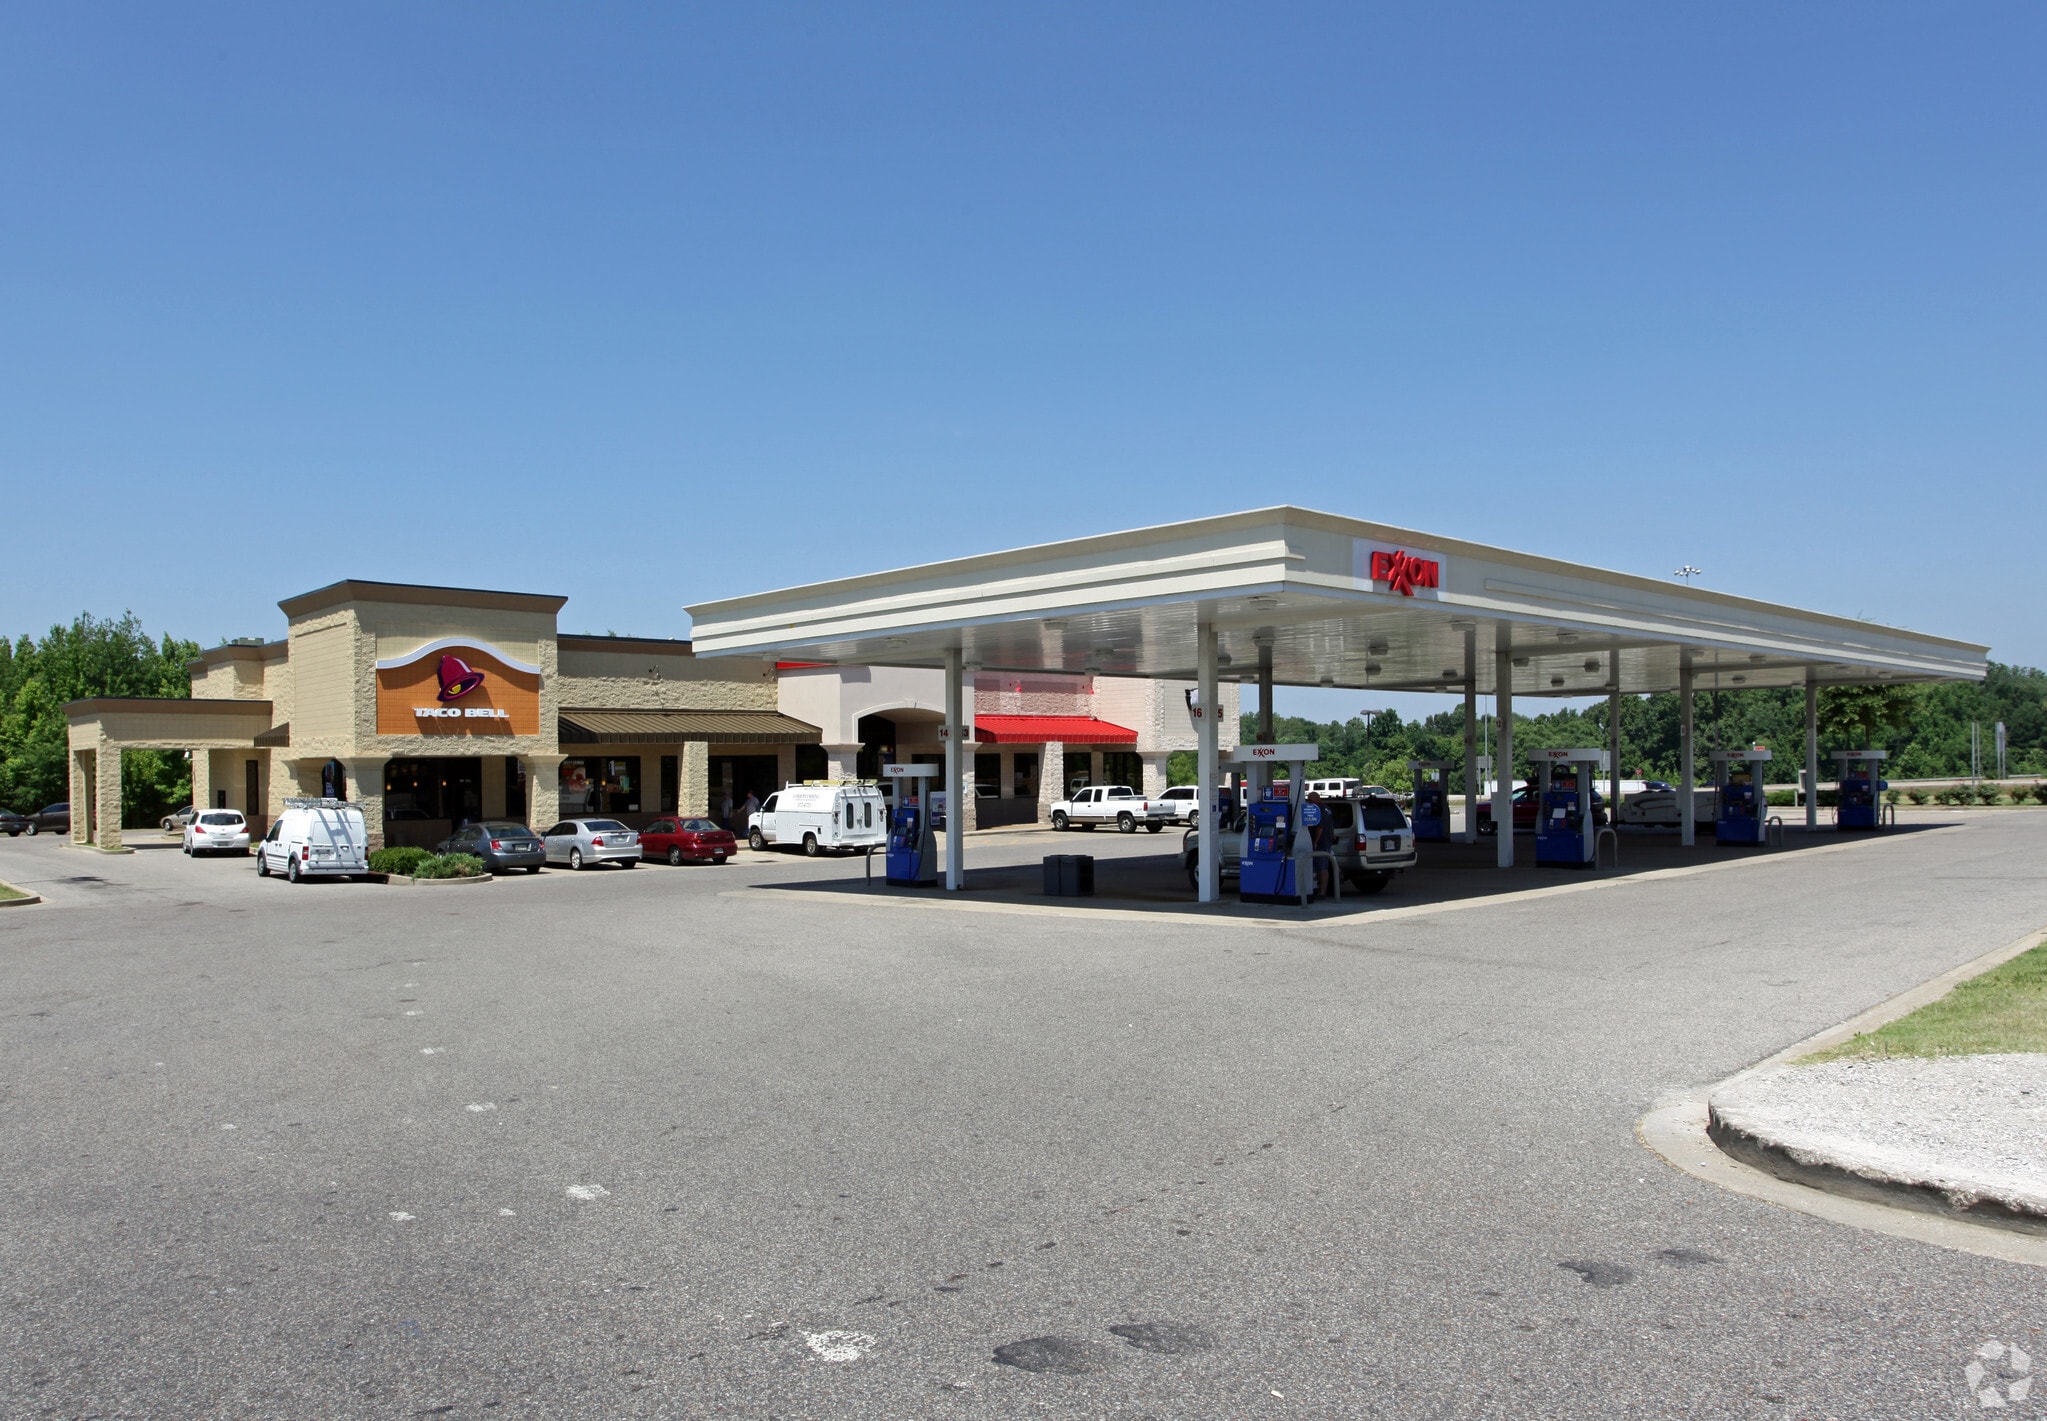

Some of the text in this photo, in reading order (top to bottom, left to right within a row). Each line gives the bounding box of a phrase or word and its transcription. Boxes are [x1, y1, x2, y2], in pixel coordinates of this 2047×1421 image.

[1371, 550, 1439, 597] EXXON
[412, 708, 510, 718] TACO BELL
[1193, 707, 1202, 718] 16
[940, 728, 949, 737] 14
[1252, 748, 1275, 758] EXXON
[1548, 751, 1568, 759] EXXON
[890, 767, 904, 775] EXXON
